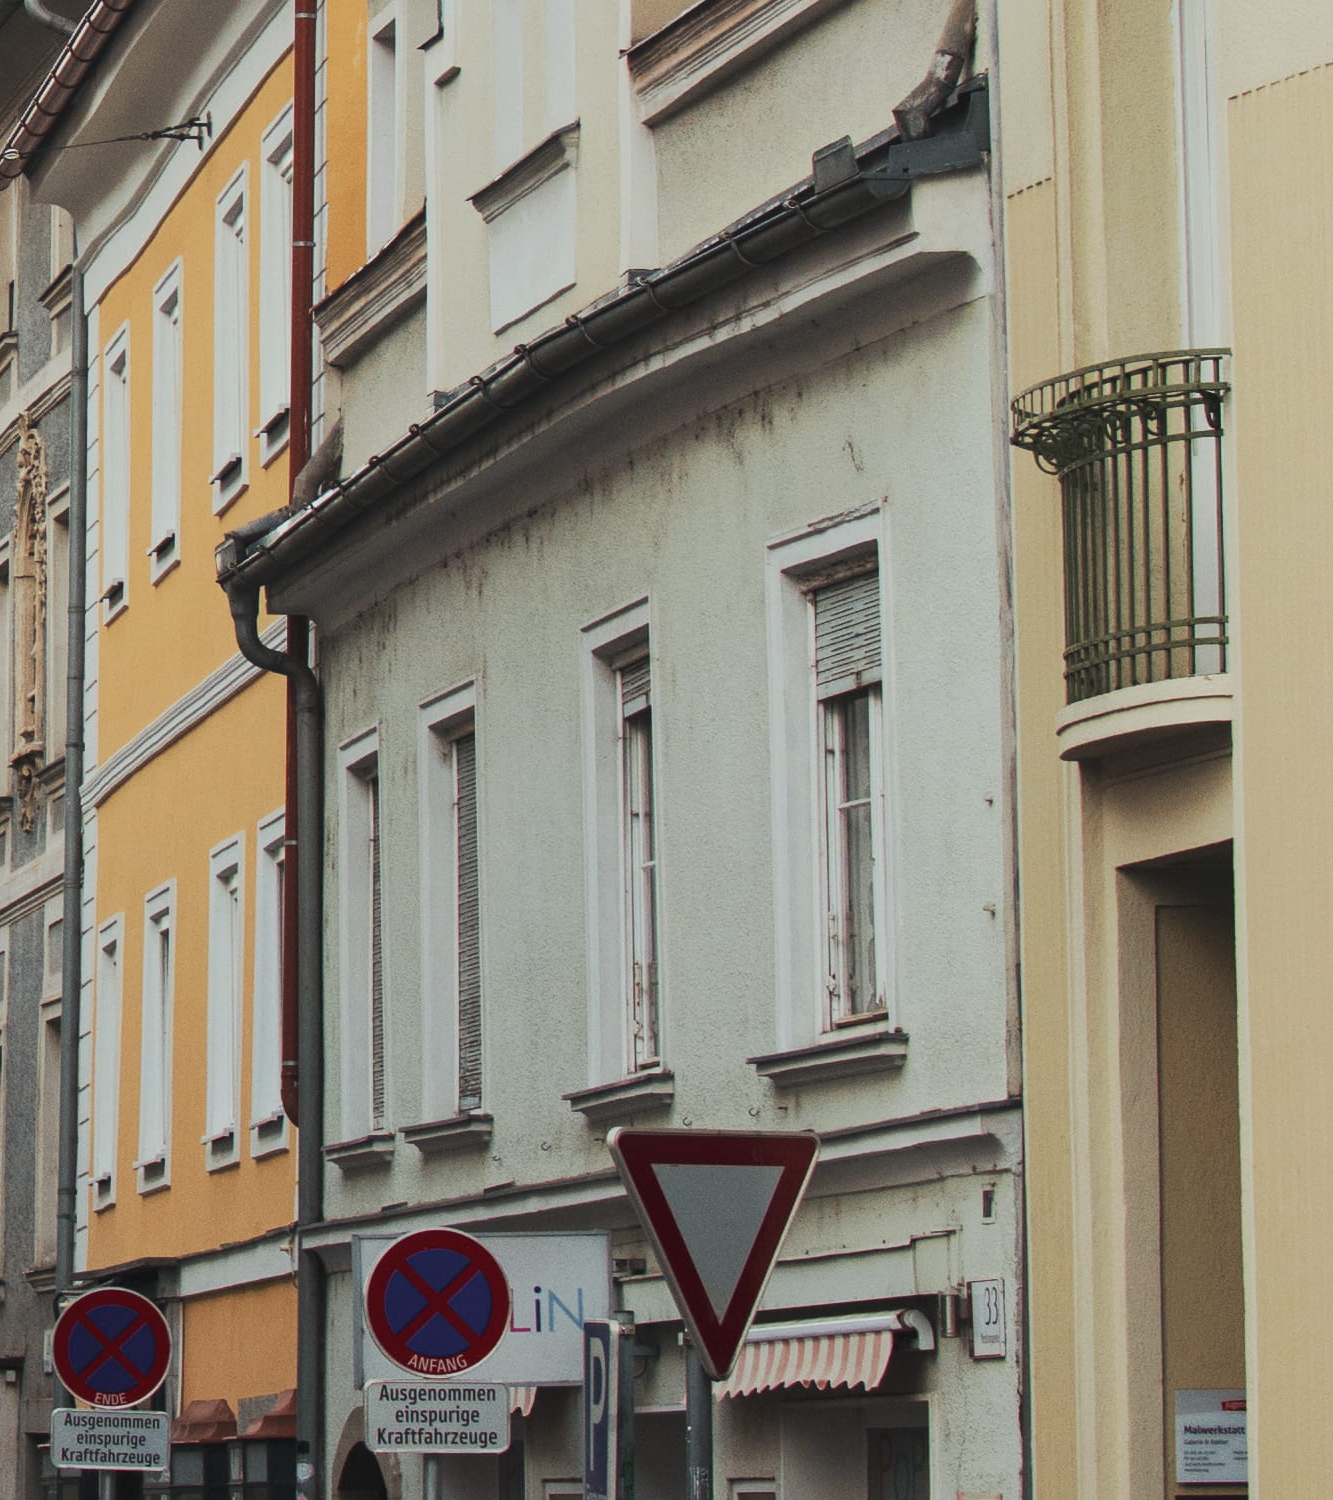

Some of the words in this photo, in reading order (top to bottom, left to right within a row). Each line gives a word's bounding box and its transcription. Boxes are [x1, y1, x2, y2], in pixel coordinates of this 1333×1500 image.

[985, 1286, 998, 1326] 33
[407, 1354, 468, 1373] ANFANG
[94, 1392, 127, 1405] ENDE
[379, 1385, 496, 1402] Ausgenommen
[64, 1413, 160, 1429] Ausgenommen
[395, 1406, 480, 1426] einspurige
[76, 1430, 146, 1447] einspurige
[377, 1428, 498, 1448] Kraftfahrzeuge
[61, 1448, 161, 1467] Kraftfahrzeuge
